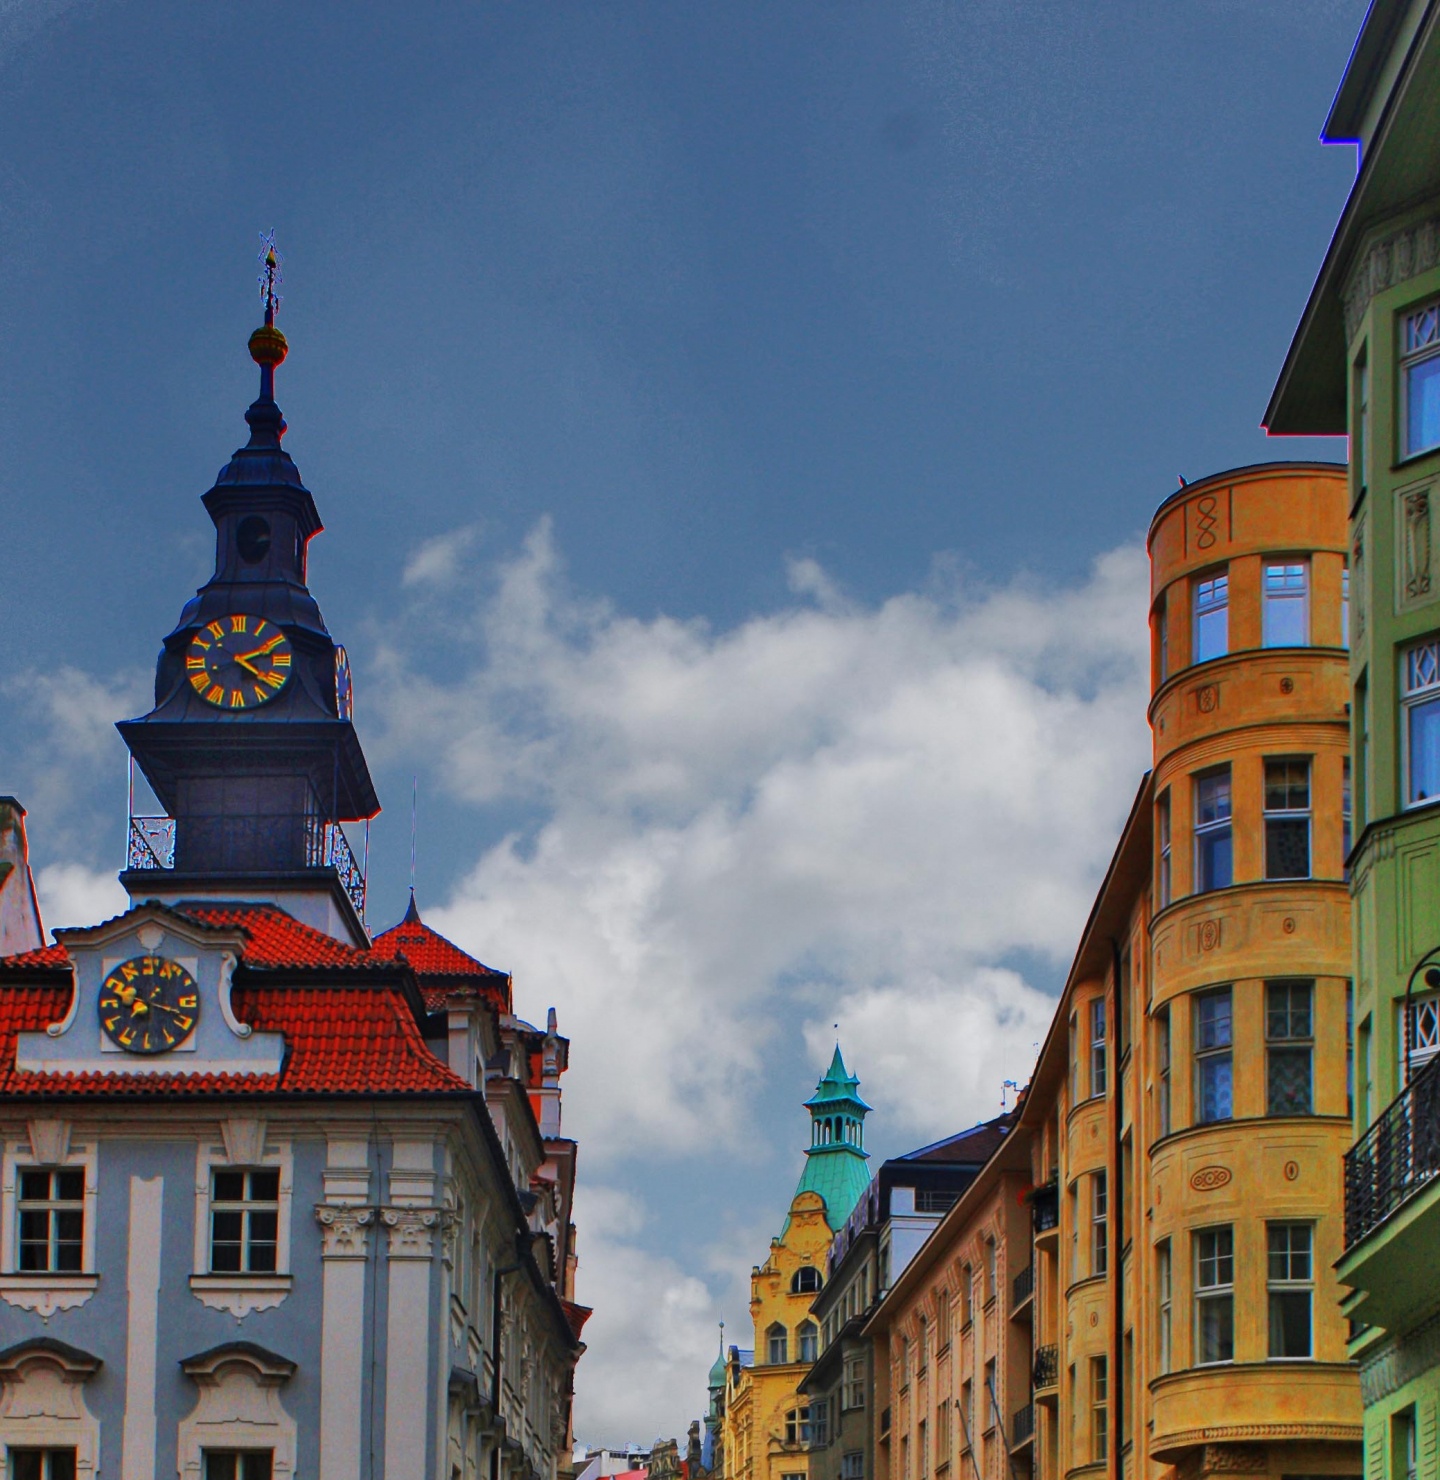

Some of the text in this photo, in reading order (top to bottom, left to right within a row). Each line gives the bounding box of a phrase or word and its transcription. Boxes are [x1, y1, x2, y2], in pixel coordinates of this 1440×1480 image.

[207, 619, 225, 640] XI
[231, 614, 247, 632] XII
[254, 617, 266, 636] I
[192, 635, 211, 651] X
[187, 656, 206, 669] IX
[272, 653, 291, 667] III
[230, 688, 245, 707] VI
[254, 683, 269, 703] V
